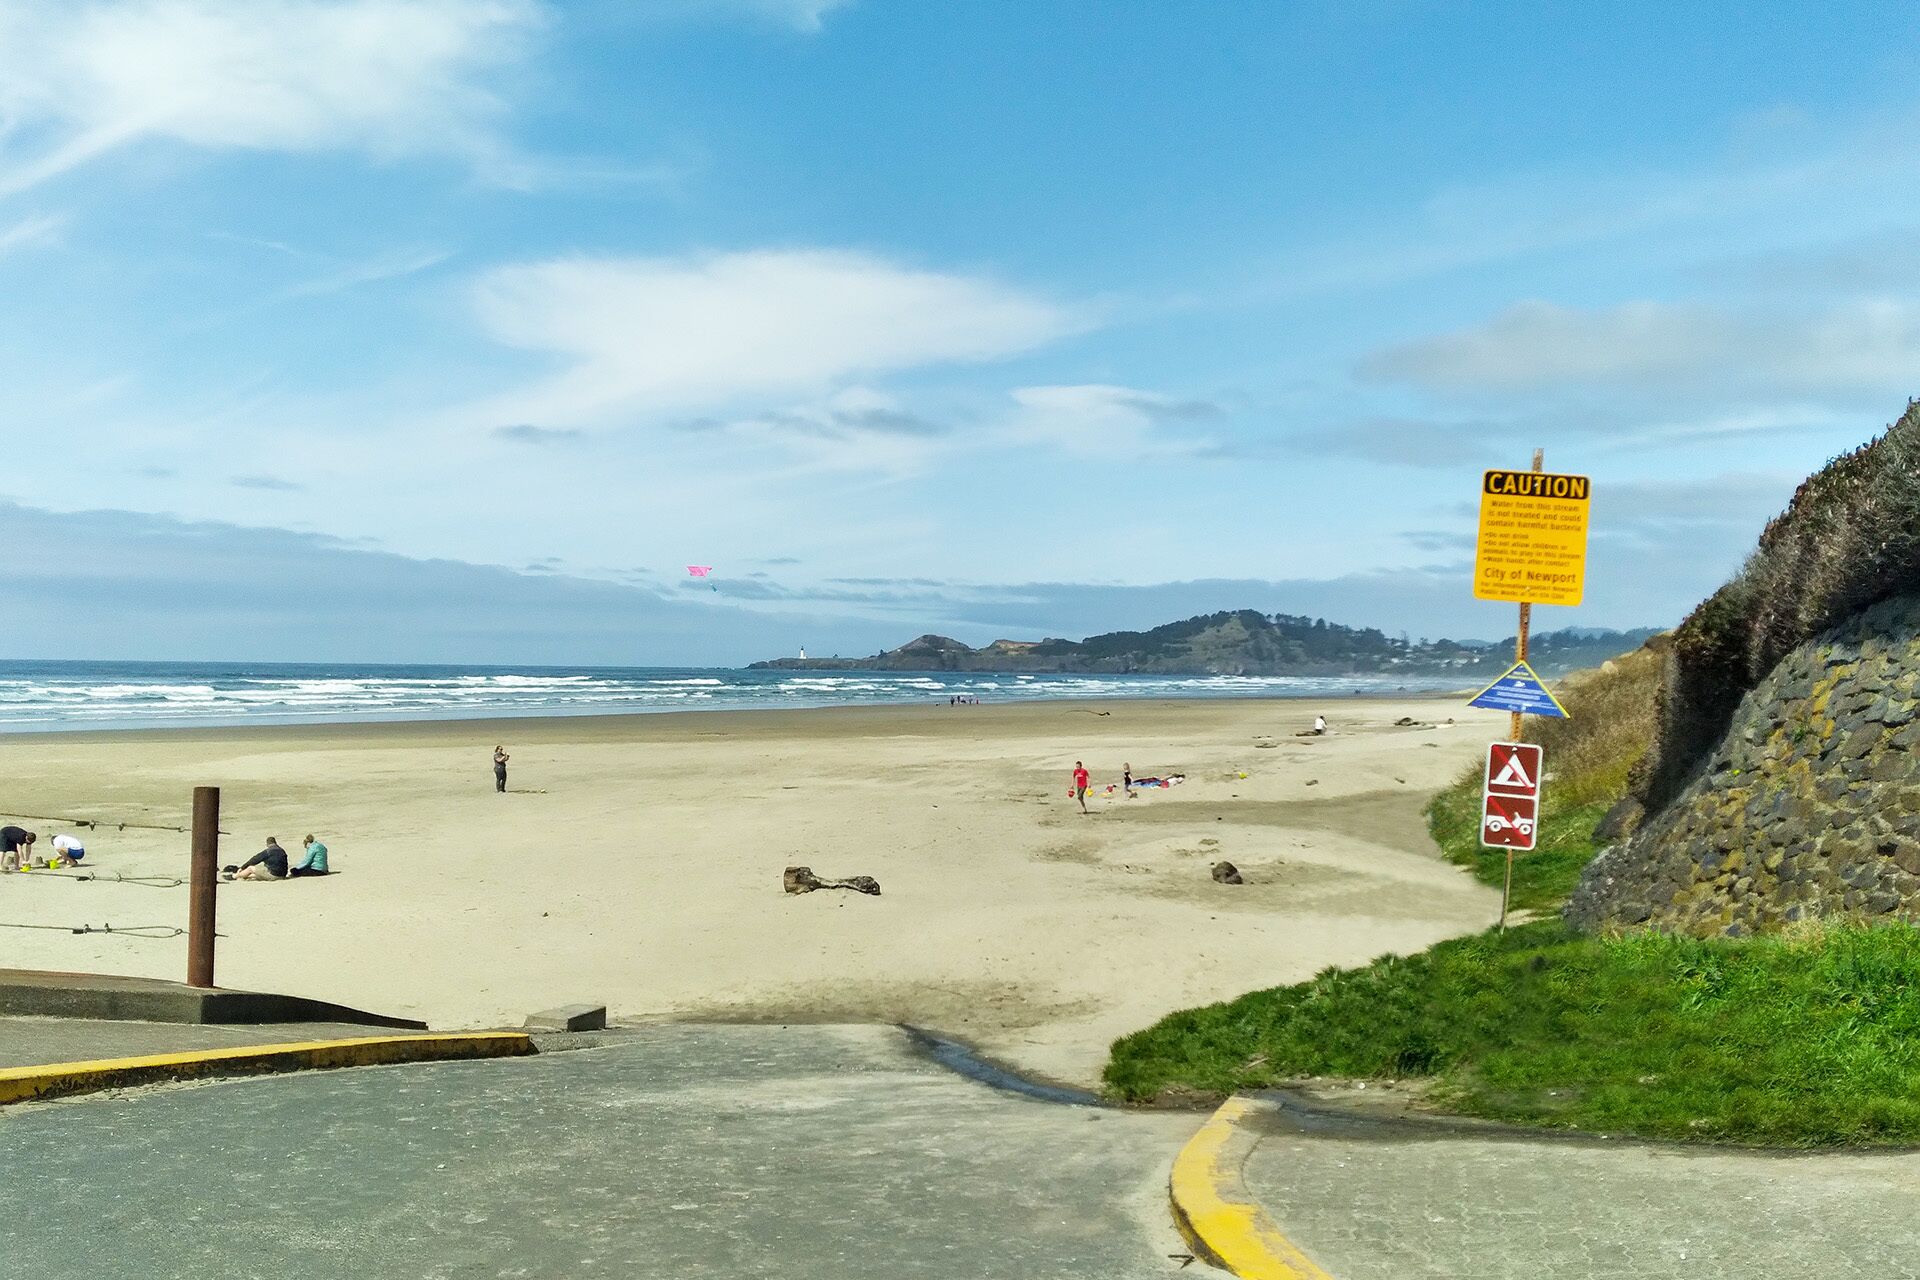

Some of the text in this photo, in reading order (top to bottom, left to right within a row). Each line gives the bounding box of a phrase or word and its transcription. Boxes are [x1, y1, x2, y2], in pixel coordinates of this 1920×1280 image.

[1489, 473, 1585, 498] CAUTION
[1513, 511, 1540, 519] treated
[1518, 521, 1548, 529] harmful
[1551, 523, 1582, 531] bacteria
[1484, 567, 1577, 584] City of Newport
